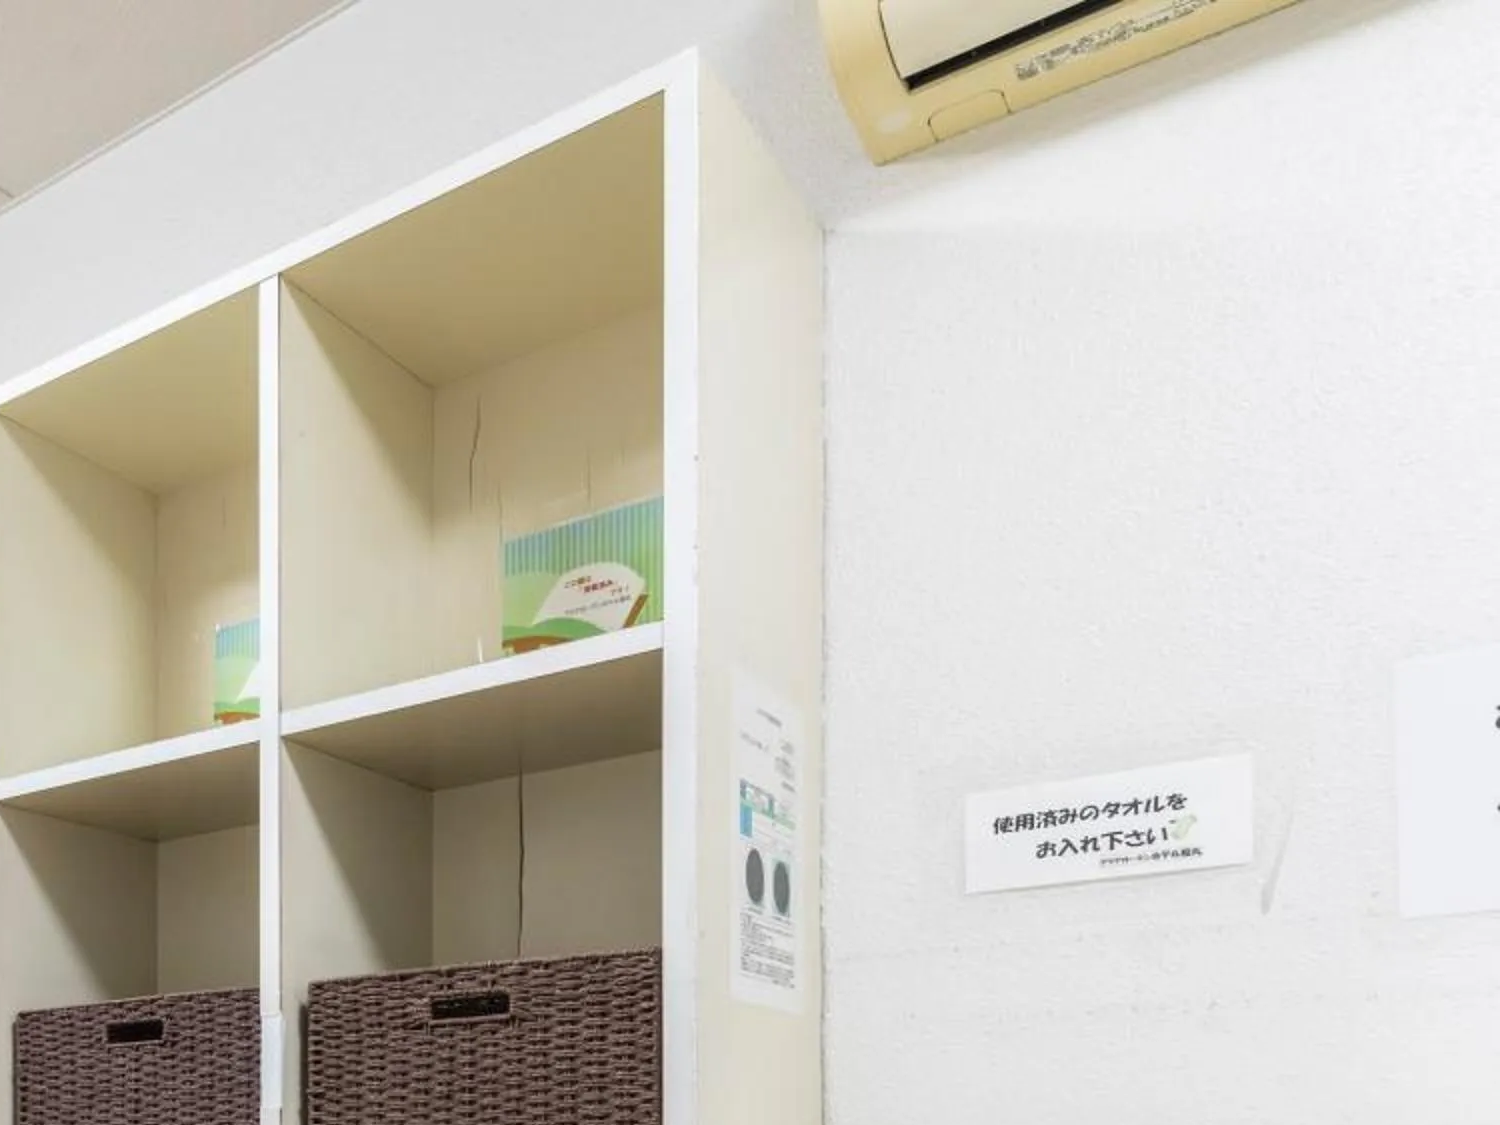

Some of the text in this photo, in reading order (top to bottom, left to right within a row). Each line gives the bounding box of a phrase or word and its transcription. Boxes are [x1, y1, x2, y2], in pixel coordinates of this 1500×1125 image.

[993, 792, 1188, 835] 使用済みのタオルを
[1034, 826, 1169, 860] お入れ下さい
